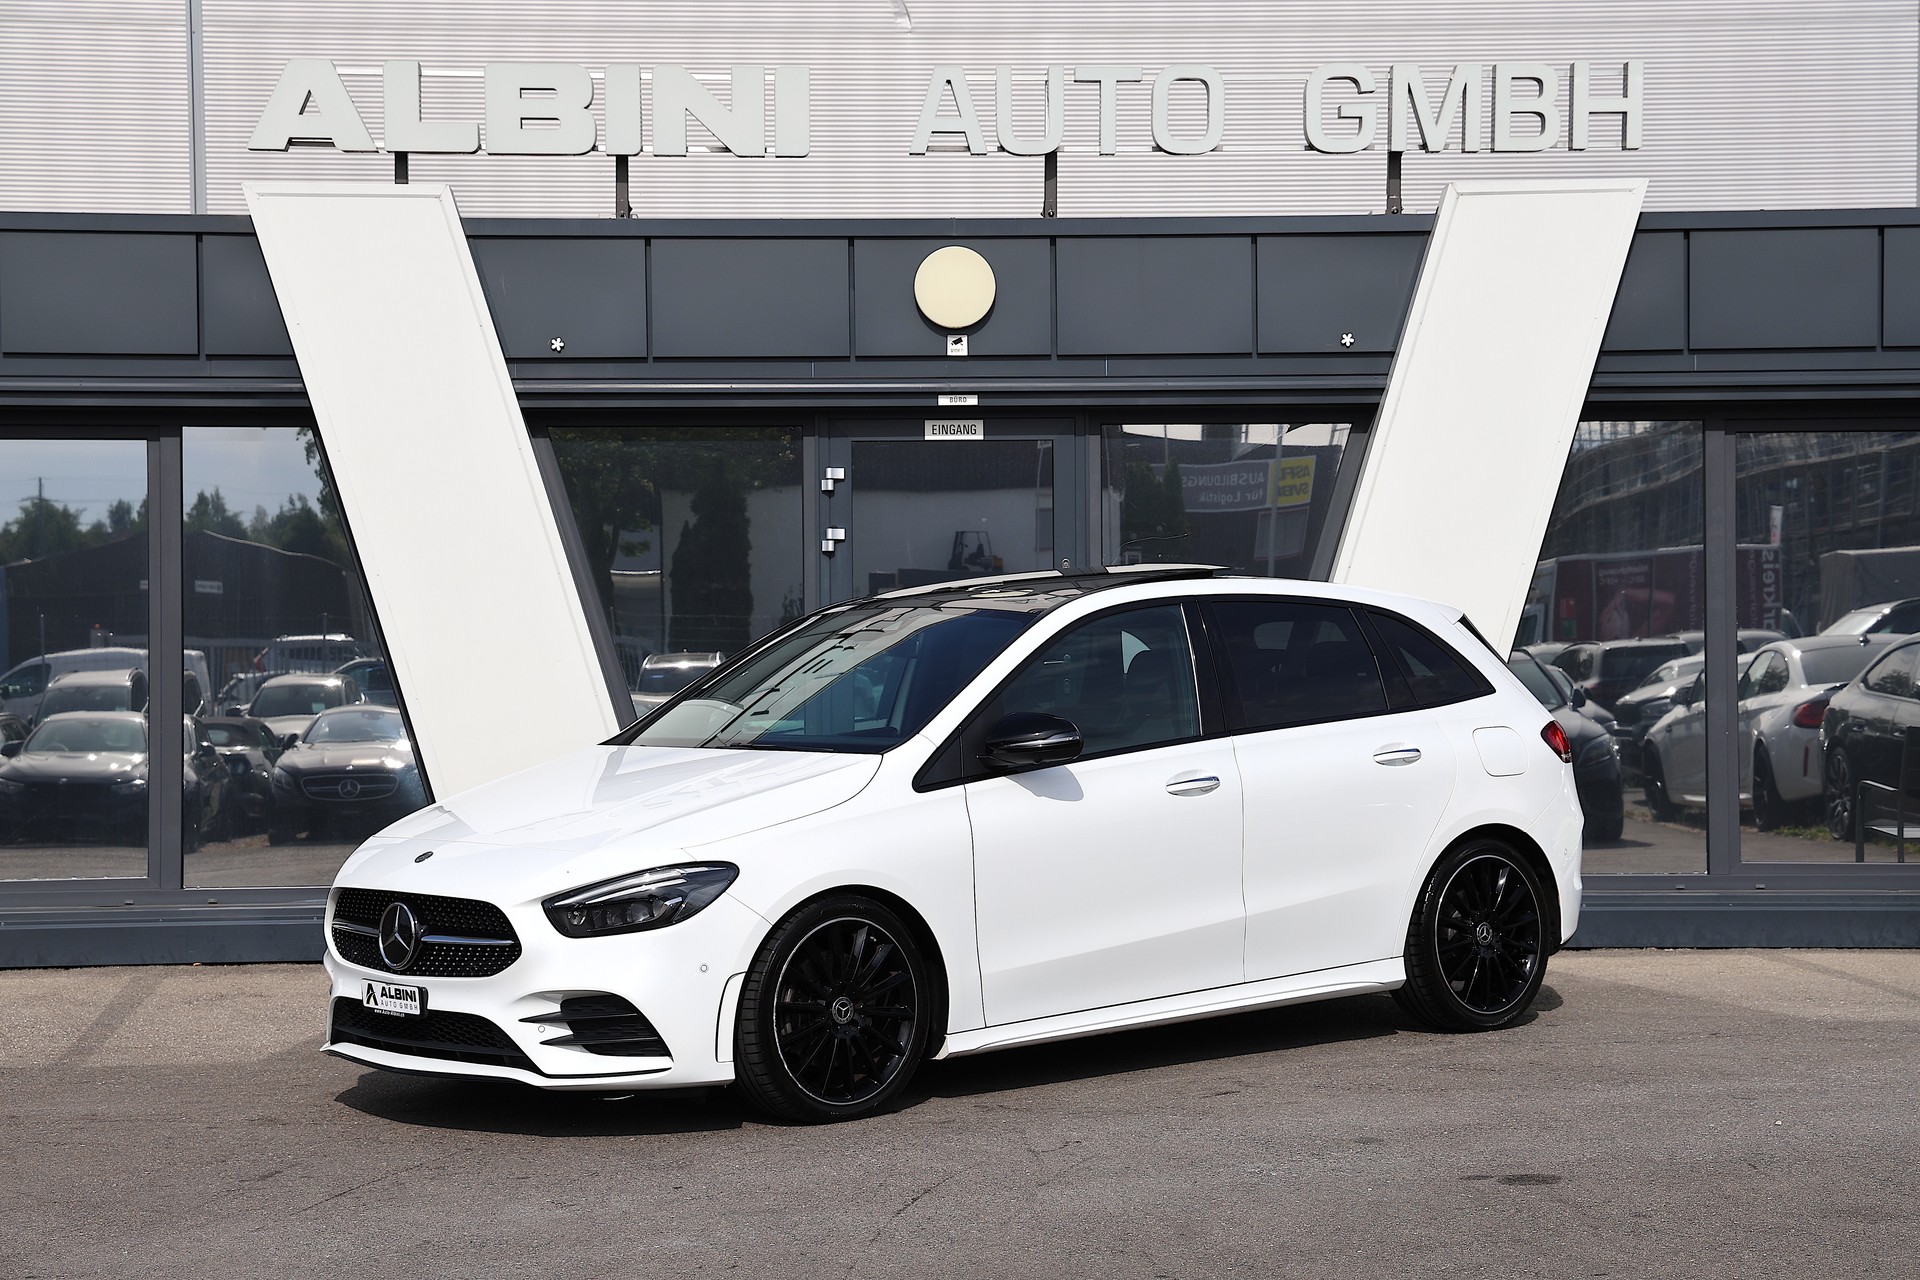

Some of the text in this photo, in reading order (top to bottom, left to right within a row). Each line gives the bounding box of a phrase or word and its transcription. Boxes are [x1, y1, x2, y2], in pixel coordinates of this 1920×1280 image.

[248, 58, 1644, 158] ALBINI AUTO GMBH
[931, 424, 977, 435] EINGANG
[381, 986, 417, 1002] ALBINI
[381, 1000, 418, 1011] AUTO GMBH
